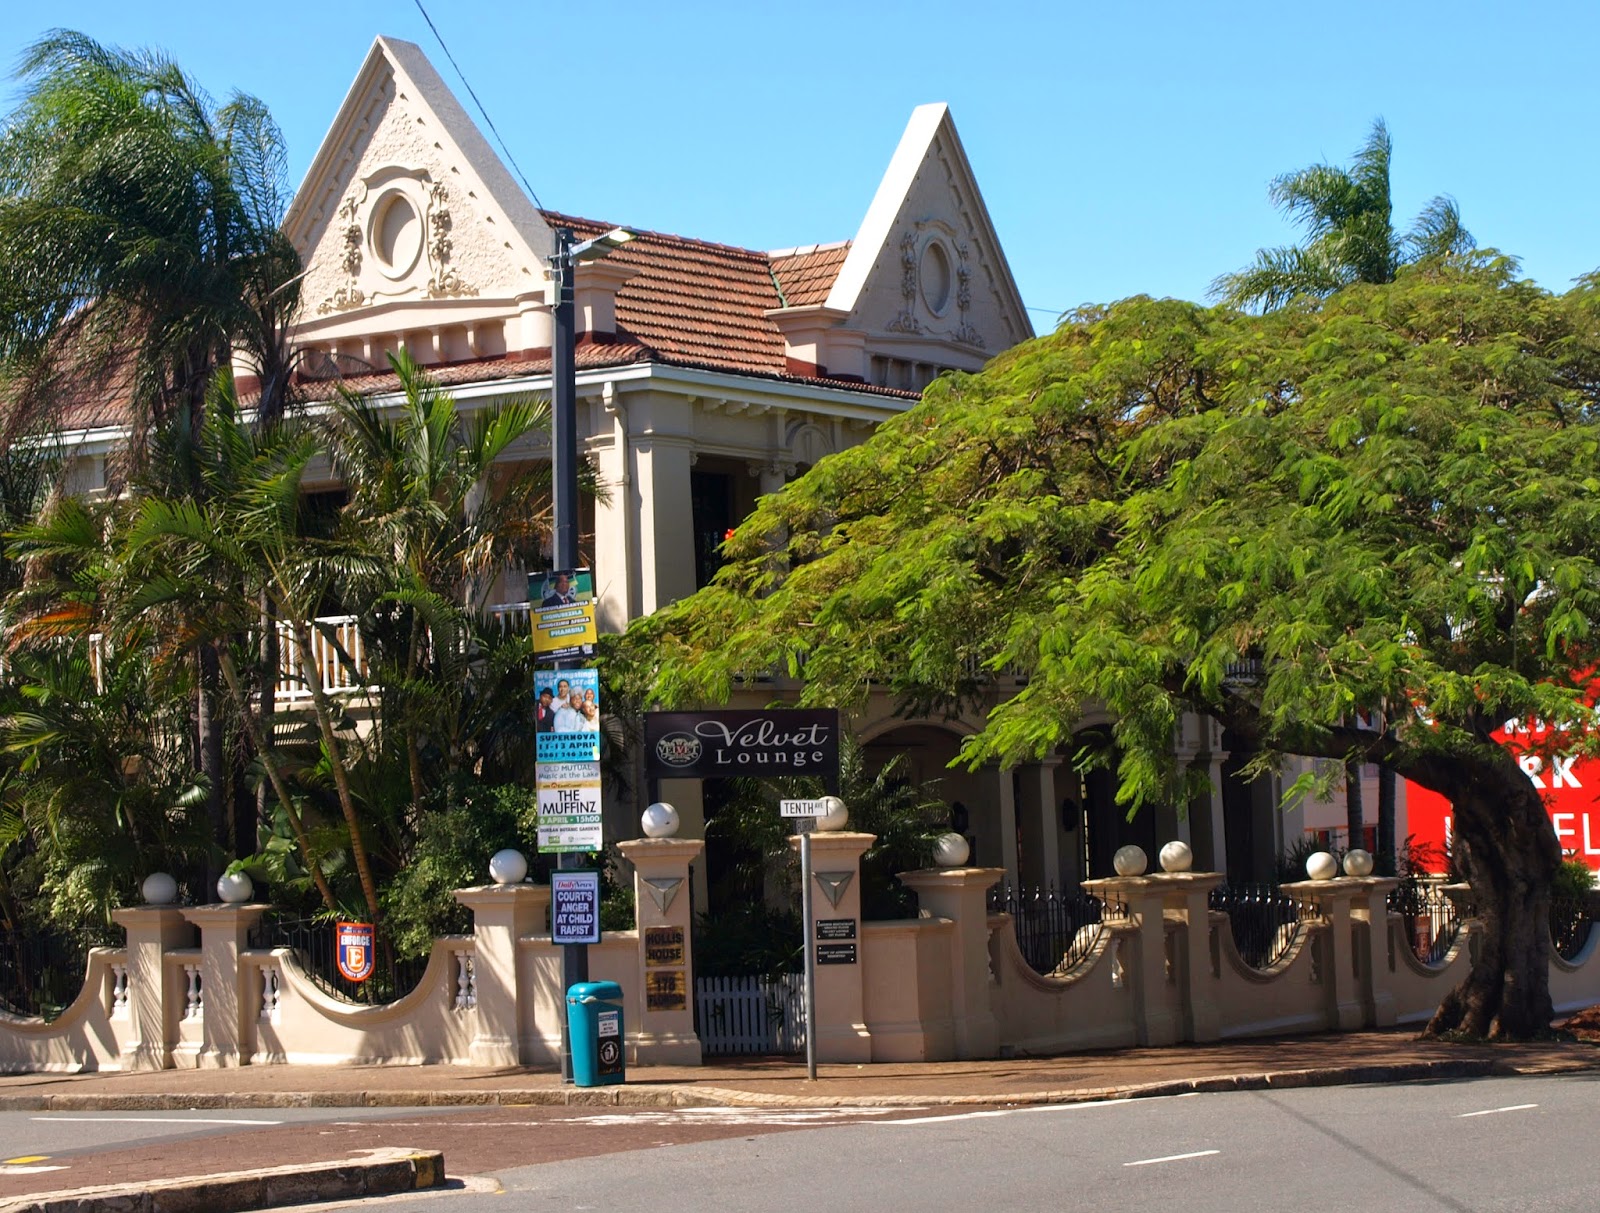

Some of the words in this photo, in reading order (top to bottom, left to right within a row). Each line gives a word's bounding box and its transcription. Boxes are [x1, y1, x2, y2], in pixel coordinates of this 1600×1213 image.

[550, 626, 584, 637] PHAMBILI
[540, 733, 596, 742] SUPERNOVA
[695, 718, 829, 748] Velvet
[659, 745, 699, 754] VELVET
[716, 749, 824, 767] Lounge
[561, 764, 592, 772] MUTUAL
[582, 770, 599, 778] Lake
[557, 789, 580, 802] THE
[542, 801, 596, 815] MUFFINZ
[784, 802, 814, 814] TENTH
[547, 816, 568, 824] APRIL
[576, 815, 600, 823] 15h00
[557, 880, 575, 890] Daily
[557, 891, 593, 901] COURT'S
[560, 902, 589, 913] ANGER
[556, 914, 567, 924] AT
[568, 913, 593, 924] CHILD
[560, 925, 590, 935] RAPIST
[340, 935, 371, 946] ENFORCE
[646, 932, 682, 945] HOLLIS
[349, 948, 363, 967] E
[647, 948, 682, 960] HOUSE
